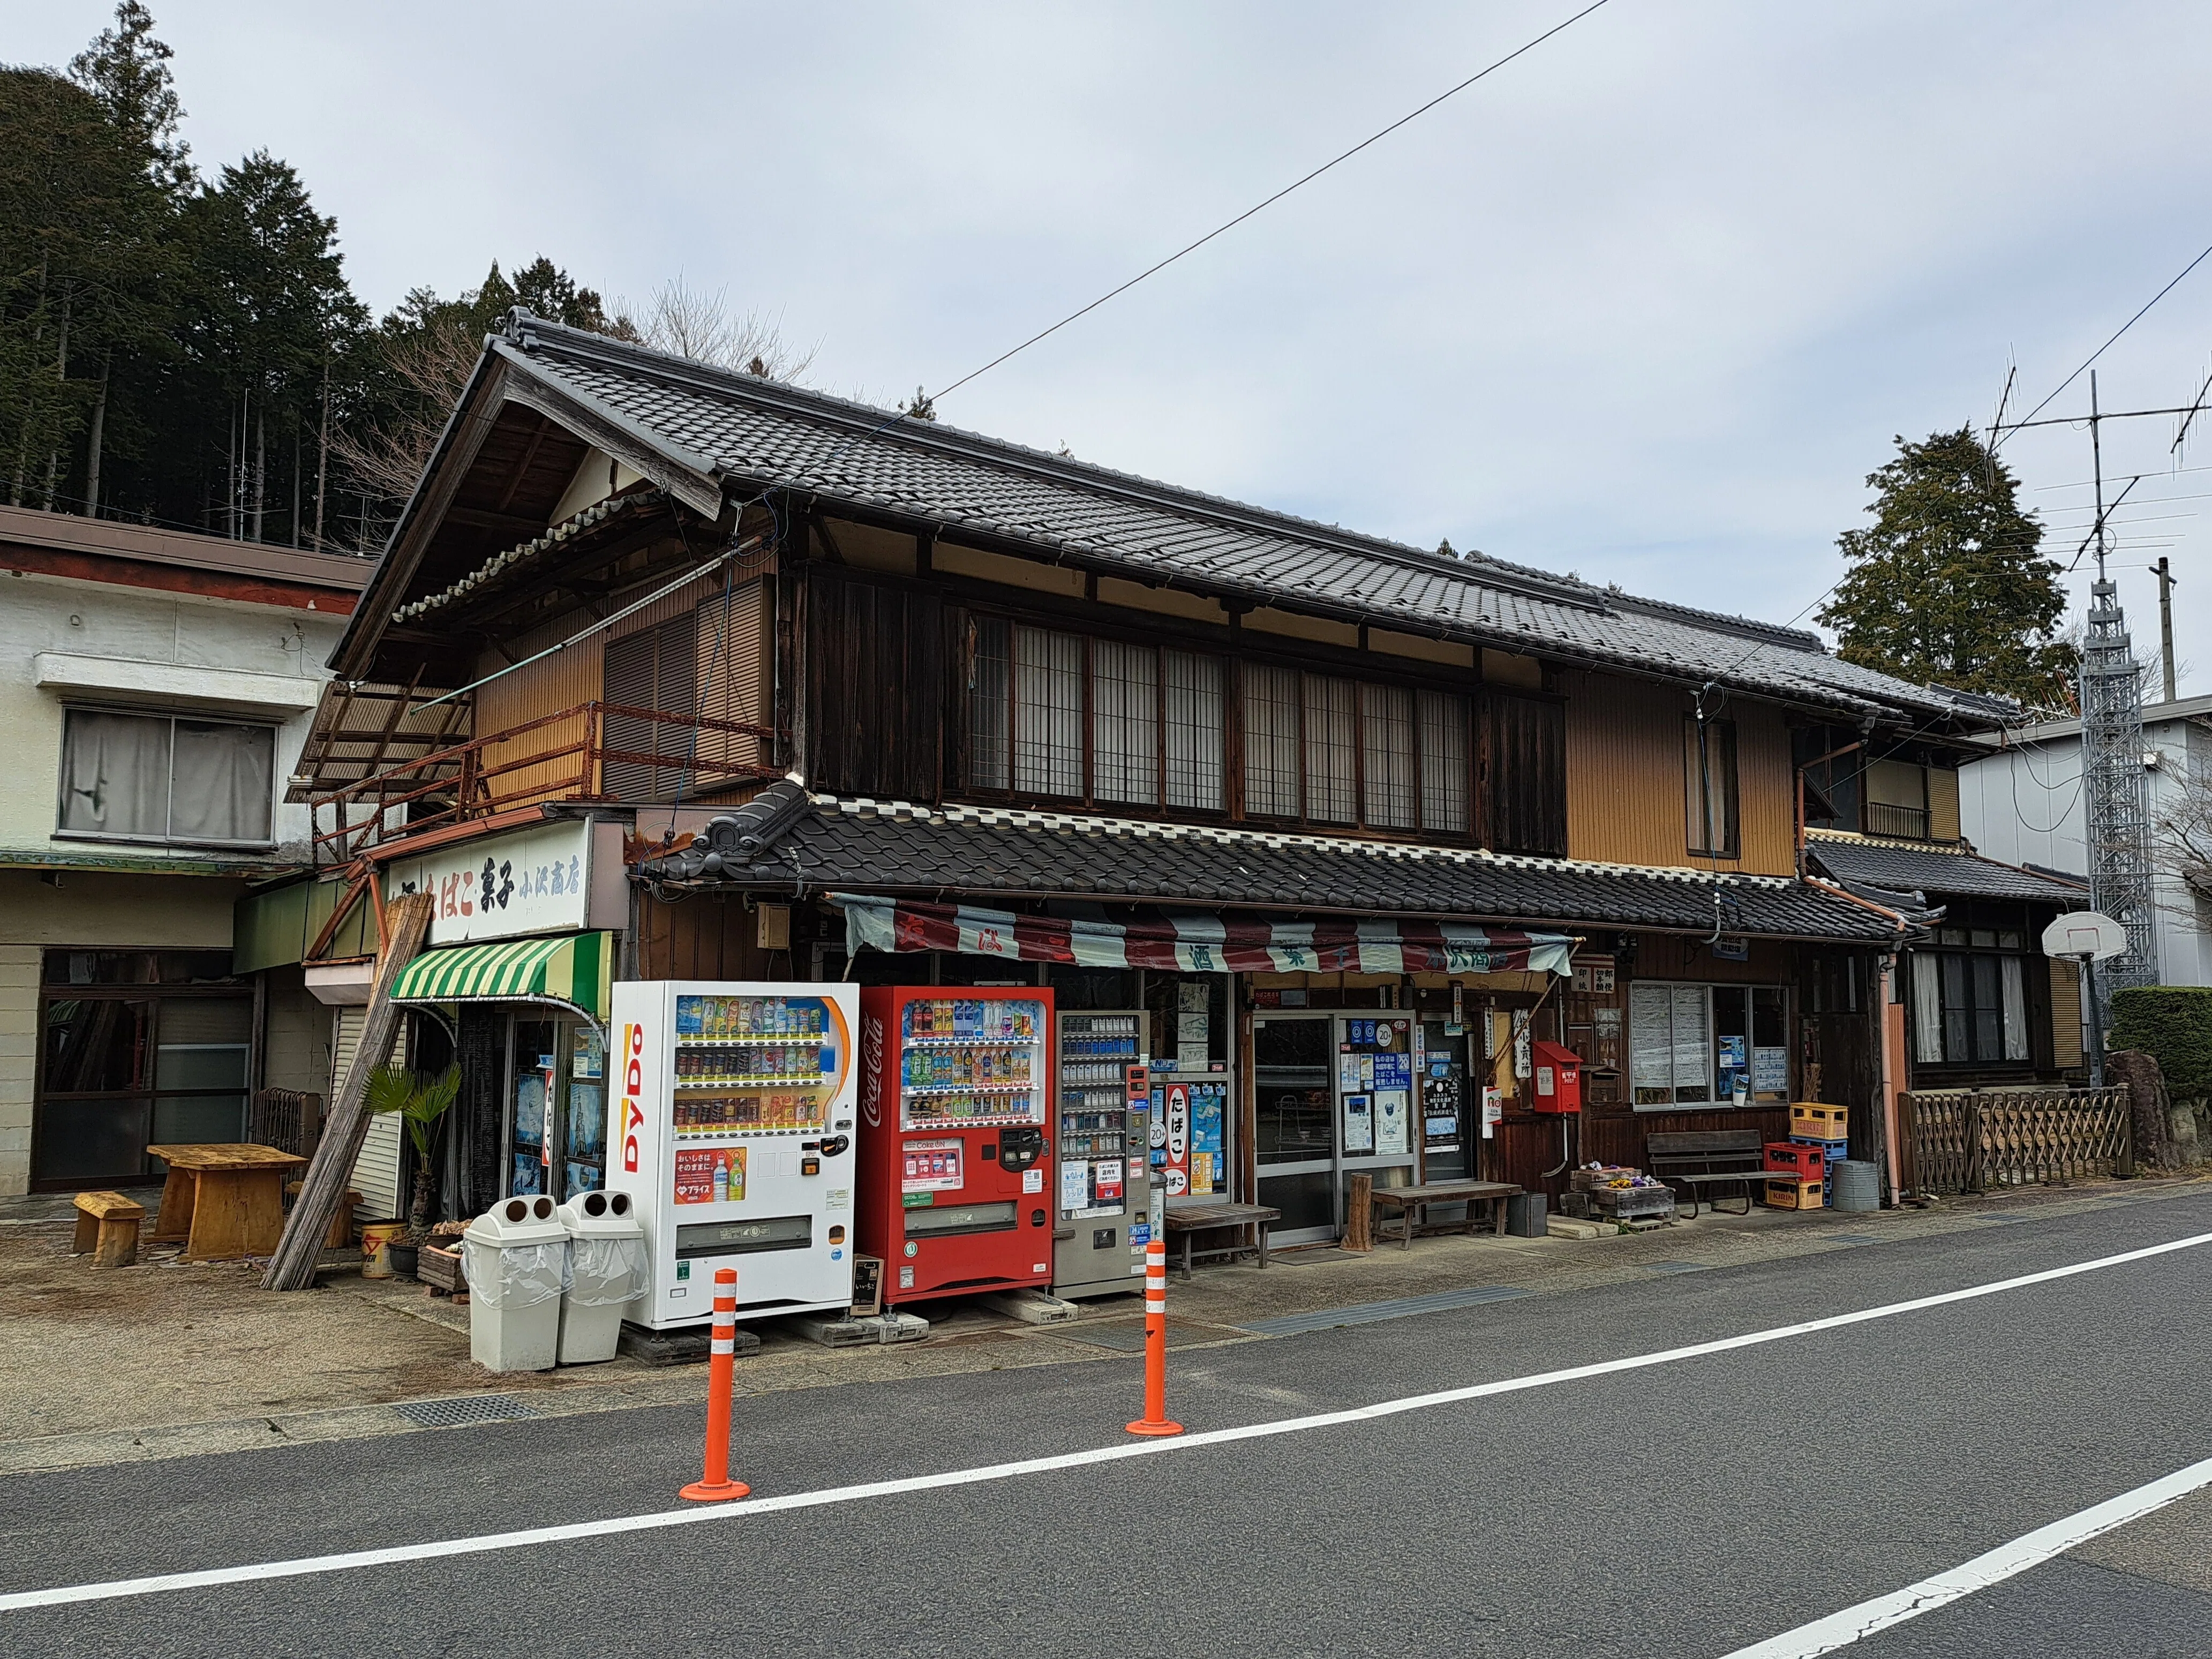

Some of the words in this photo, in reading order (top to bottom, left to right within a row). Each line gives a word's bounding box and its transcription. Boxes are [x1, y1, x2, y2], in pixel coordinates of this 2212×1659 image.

[519, 855, 580, 900] 小沢商店
[898, 915, 1073, 960] たばこ
[1189, 945, 1214, 970] 酒
[1578, 968, 1587, 990] 印紙
[863, 1011, 883, 1128] Coca-Cola
[1171, 1097, 1184, 1154] たばこ
[677, 1154, 711, 1162] おいしさは
[677, 1163, 713, 1172] そのままに。
[1773, 1192, 1794, 1202] KIRIN
